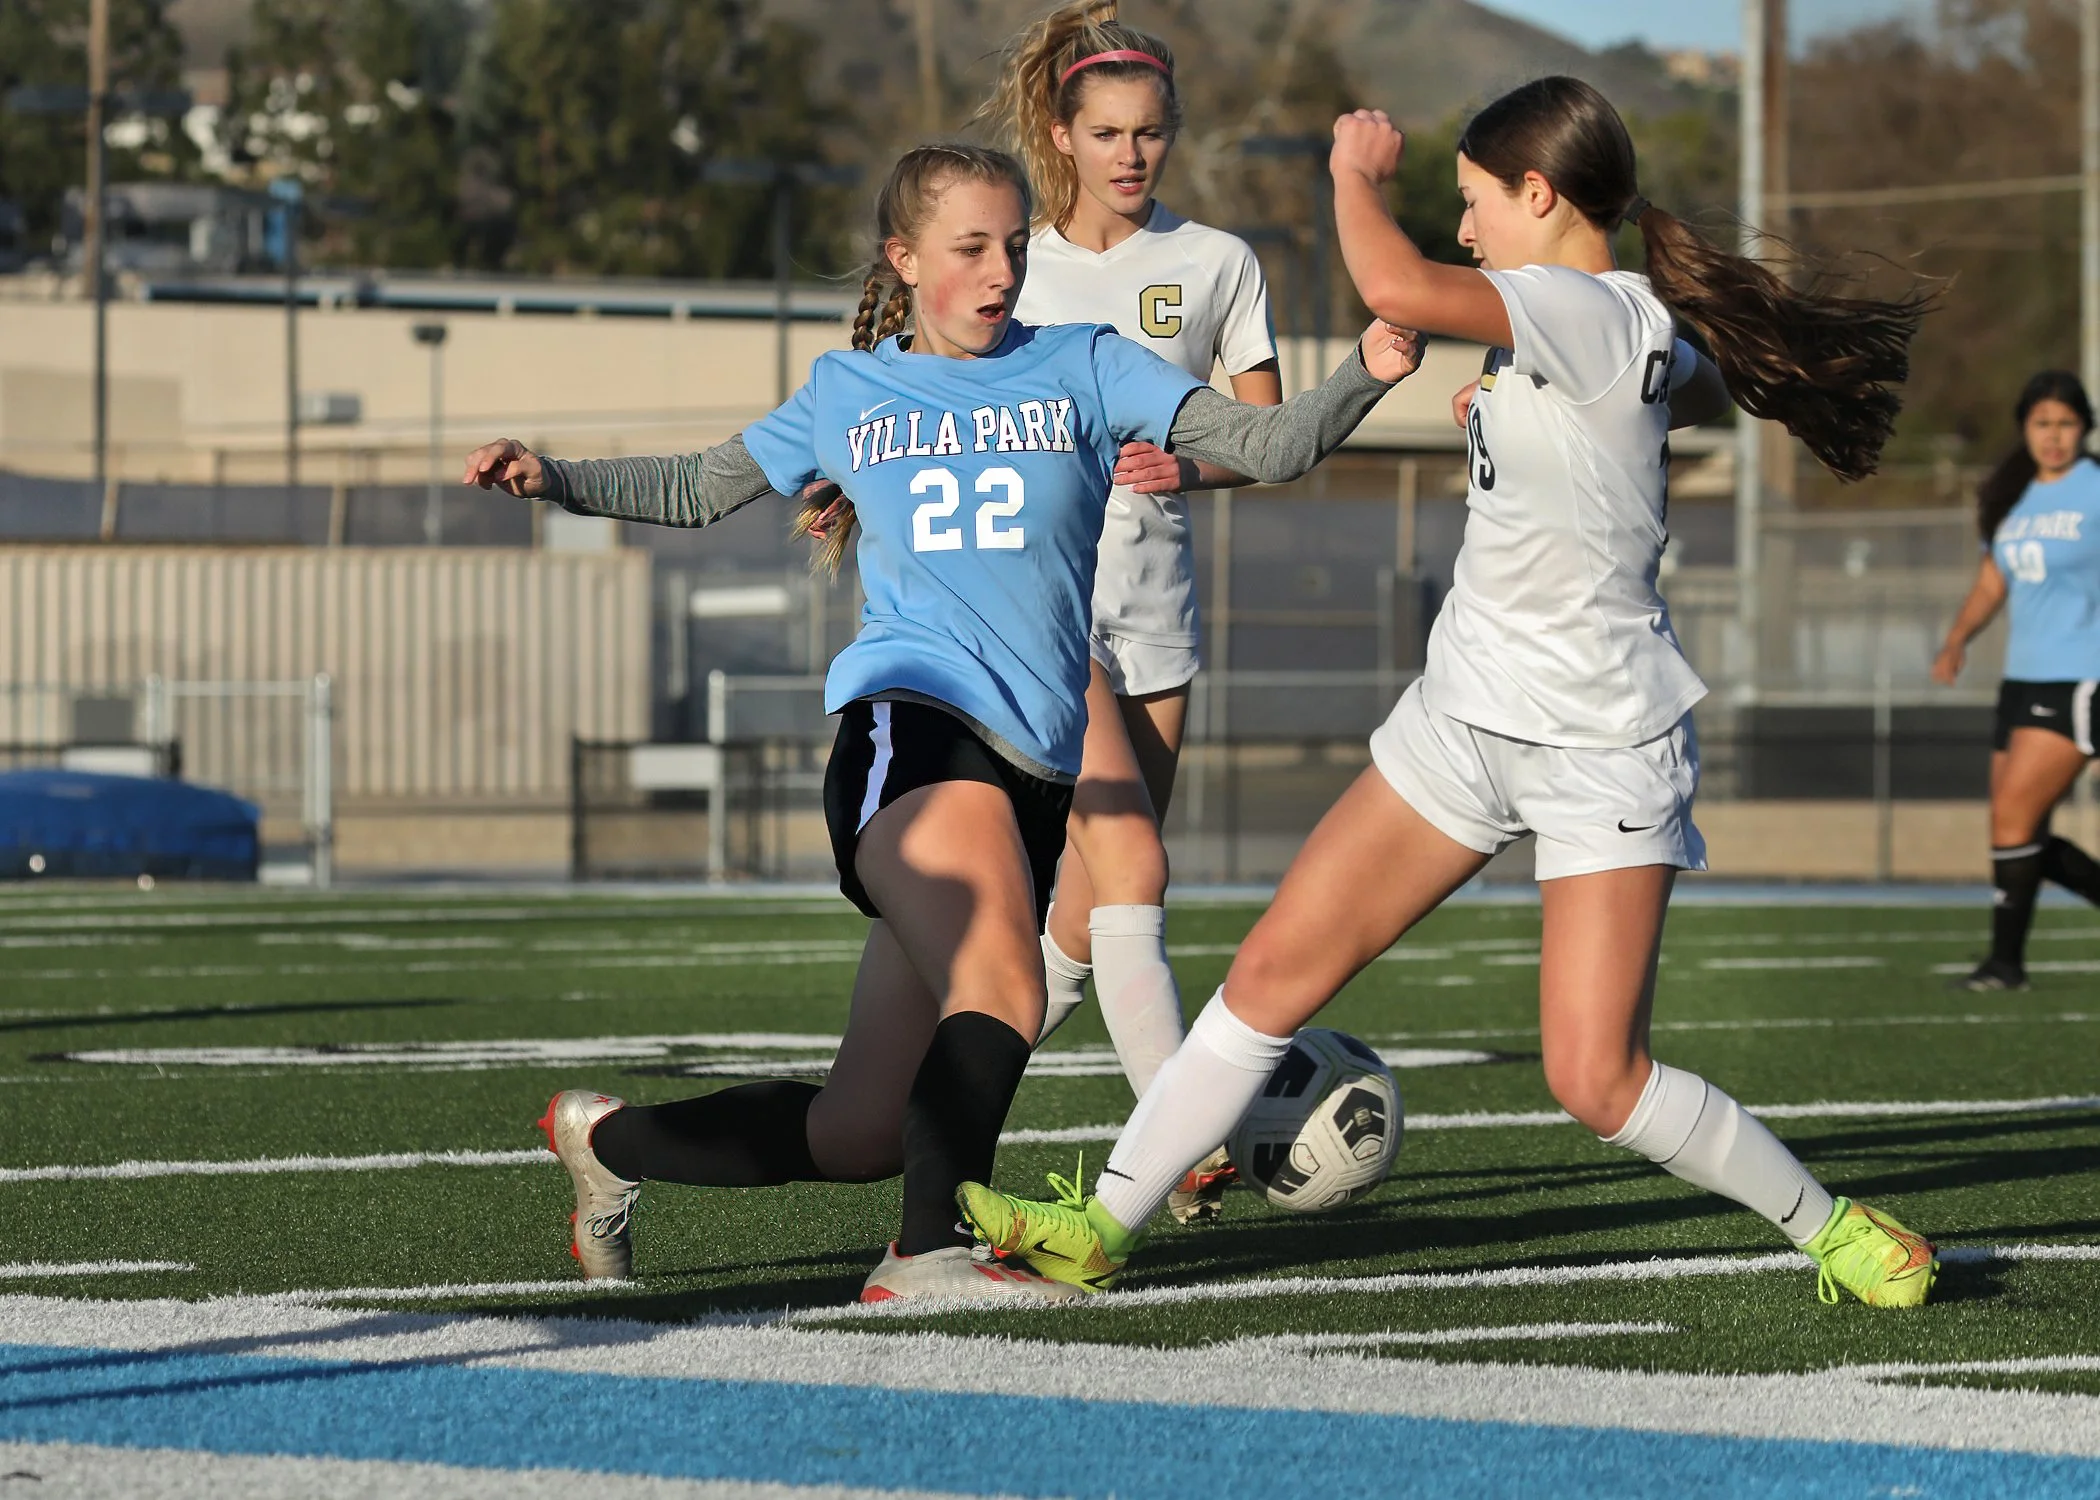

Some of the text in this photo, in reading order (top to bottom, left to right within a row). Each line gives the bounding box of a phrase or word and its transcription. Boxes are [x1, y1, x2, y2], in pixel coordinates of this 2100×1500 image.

[1139, 285, 1182, 338] C
[847, 397, 1075, 473] VILLA PARK
[909, 467, 1025, 552] 22
